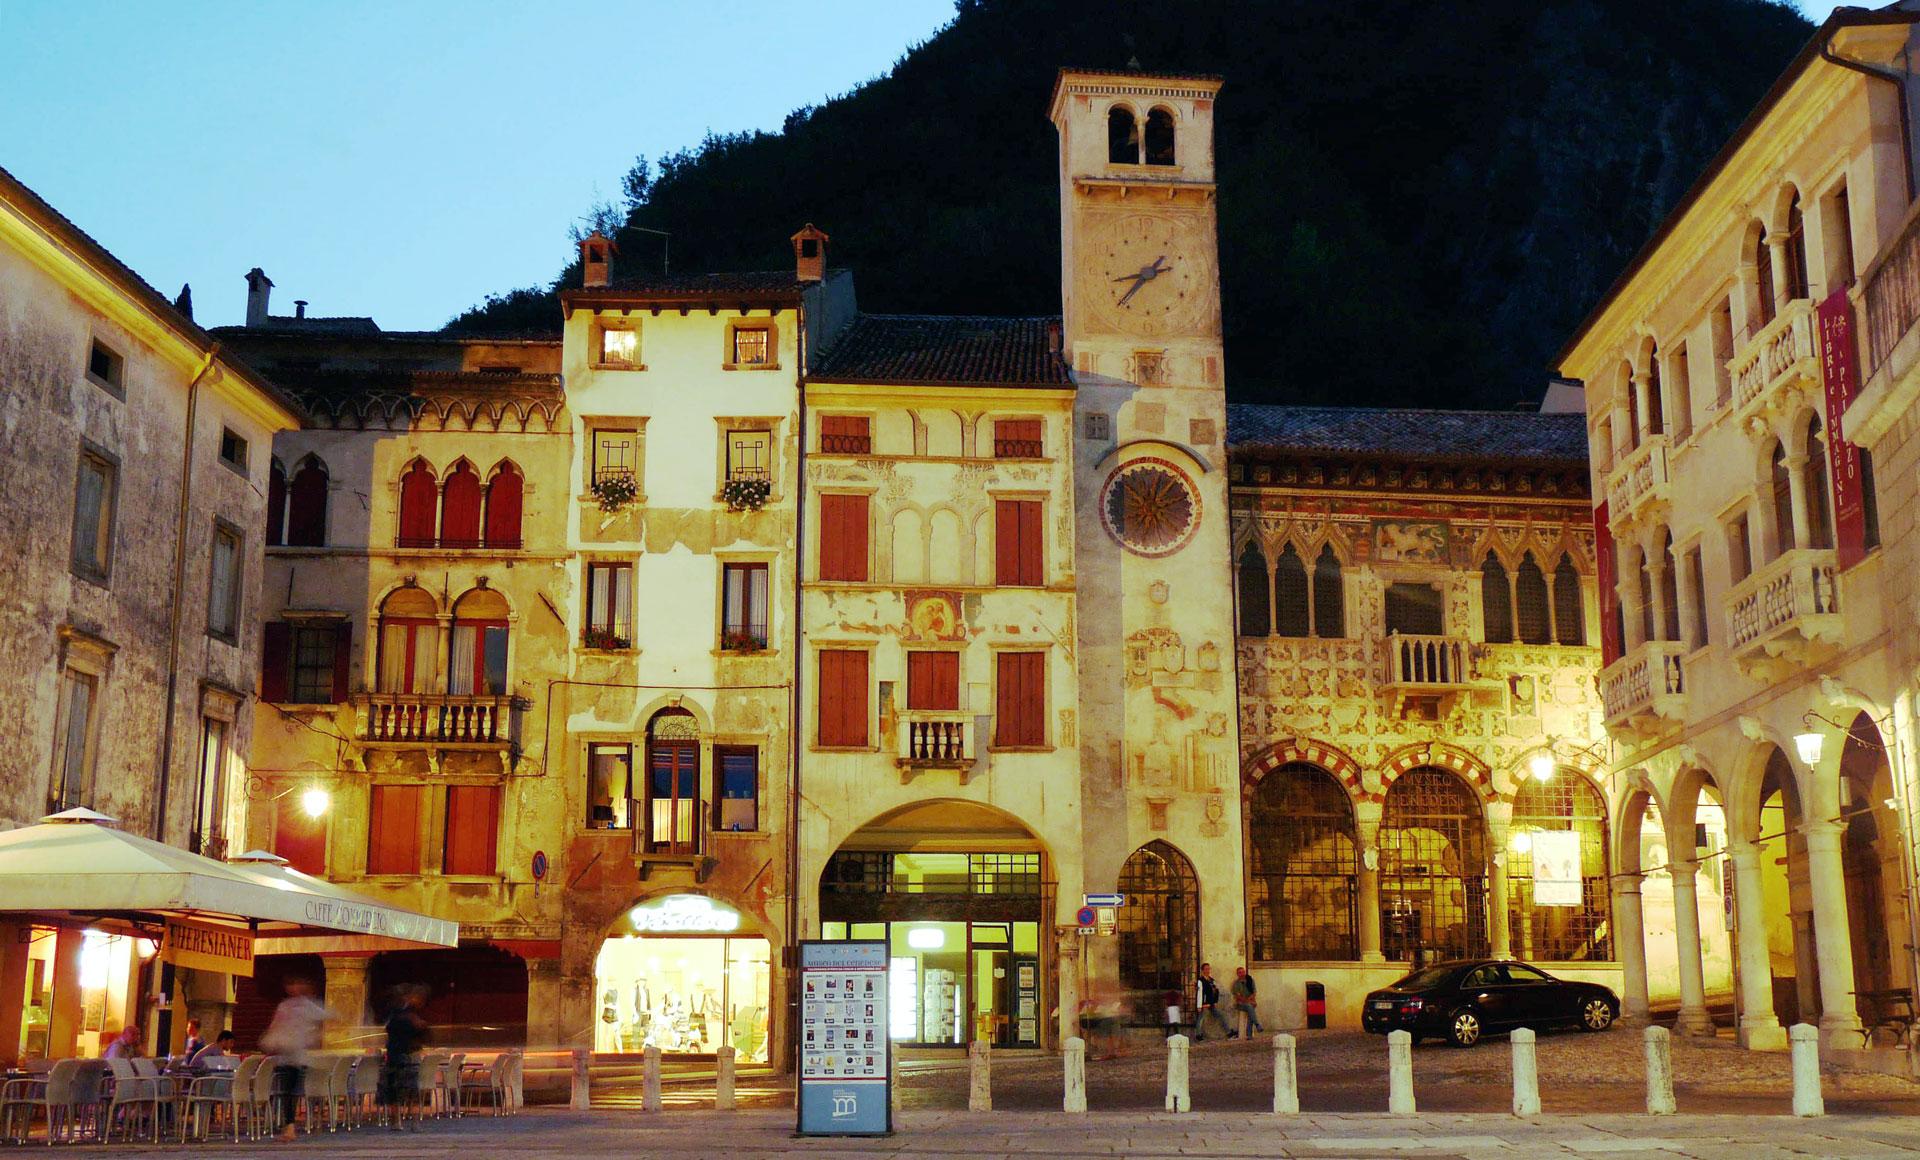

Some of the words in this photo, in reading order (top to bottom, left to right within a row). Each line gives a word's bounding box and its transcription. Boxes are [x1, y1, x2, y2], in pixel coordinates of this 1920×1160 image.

[1824, 318, 1834, 379] LIBRI
[1831, 404, 1843, 506] IMMAGINI
[169, 923, 252, 961] THERESIANER
